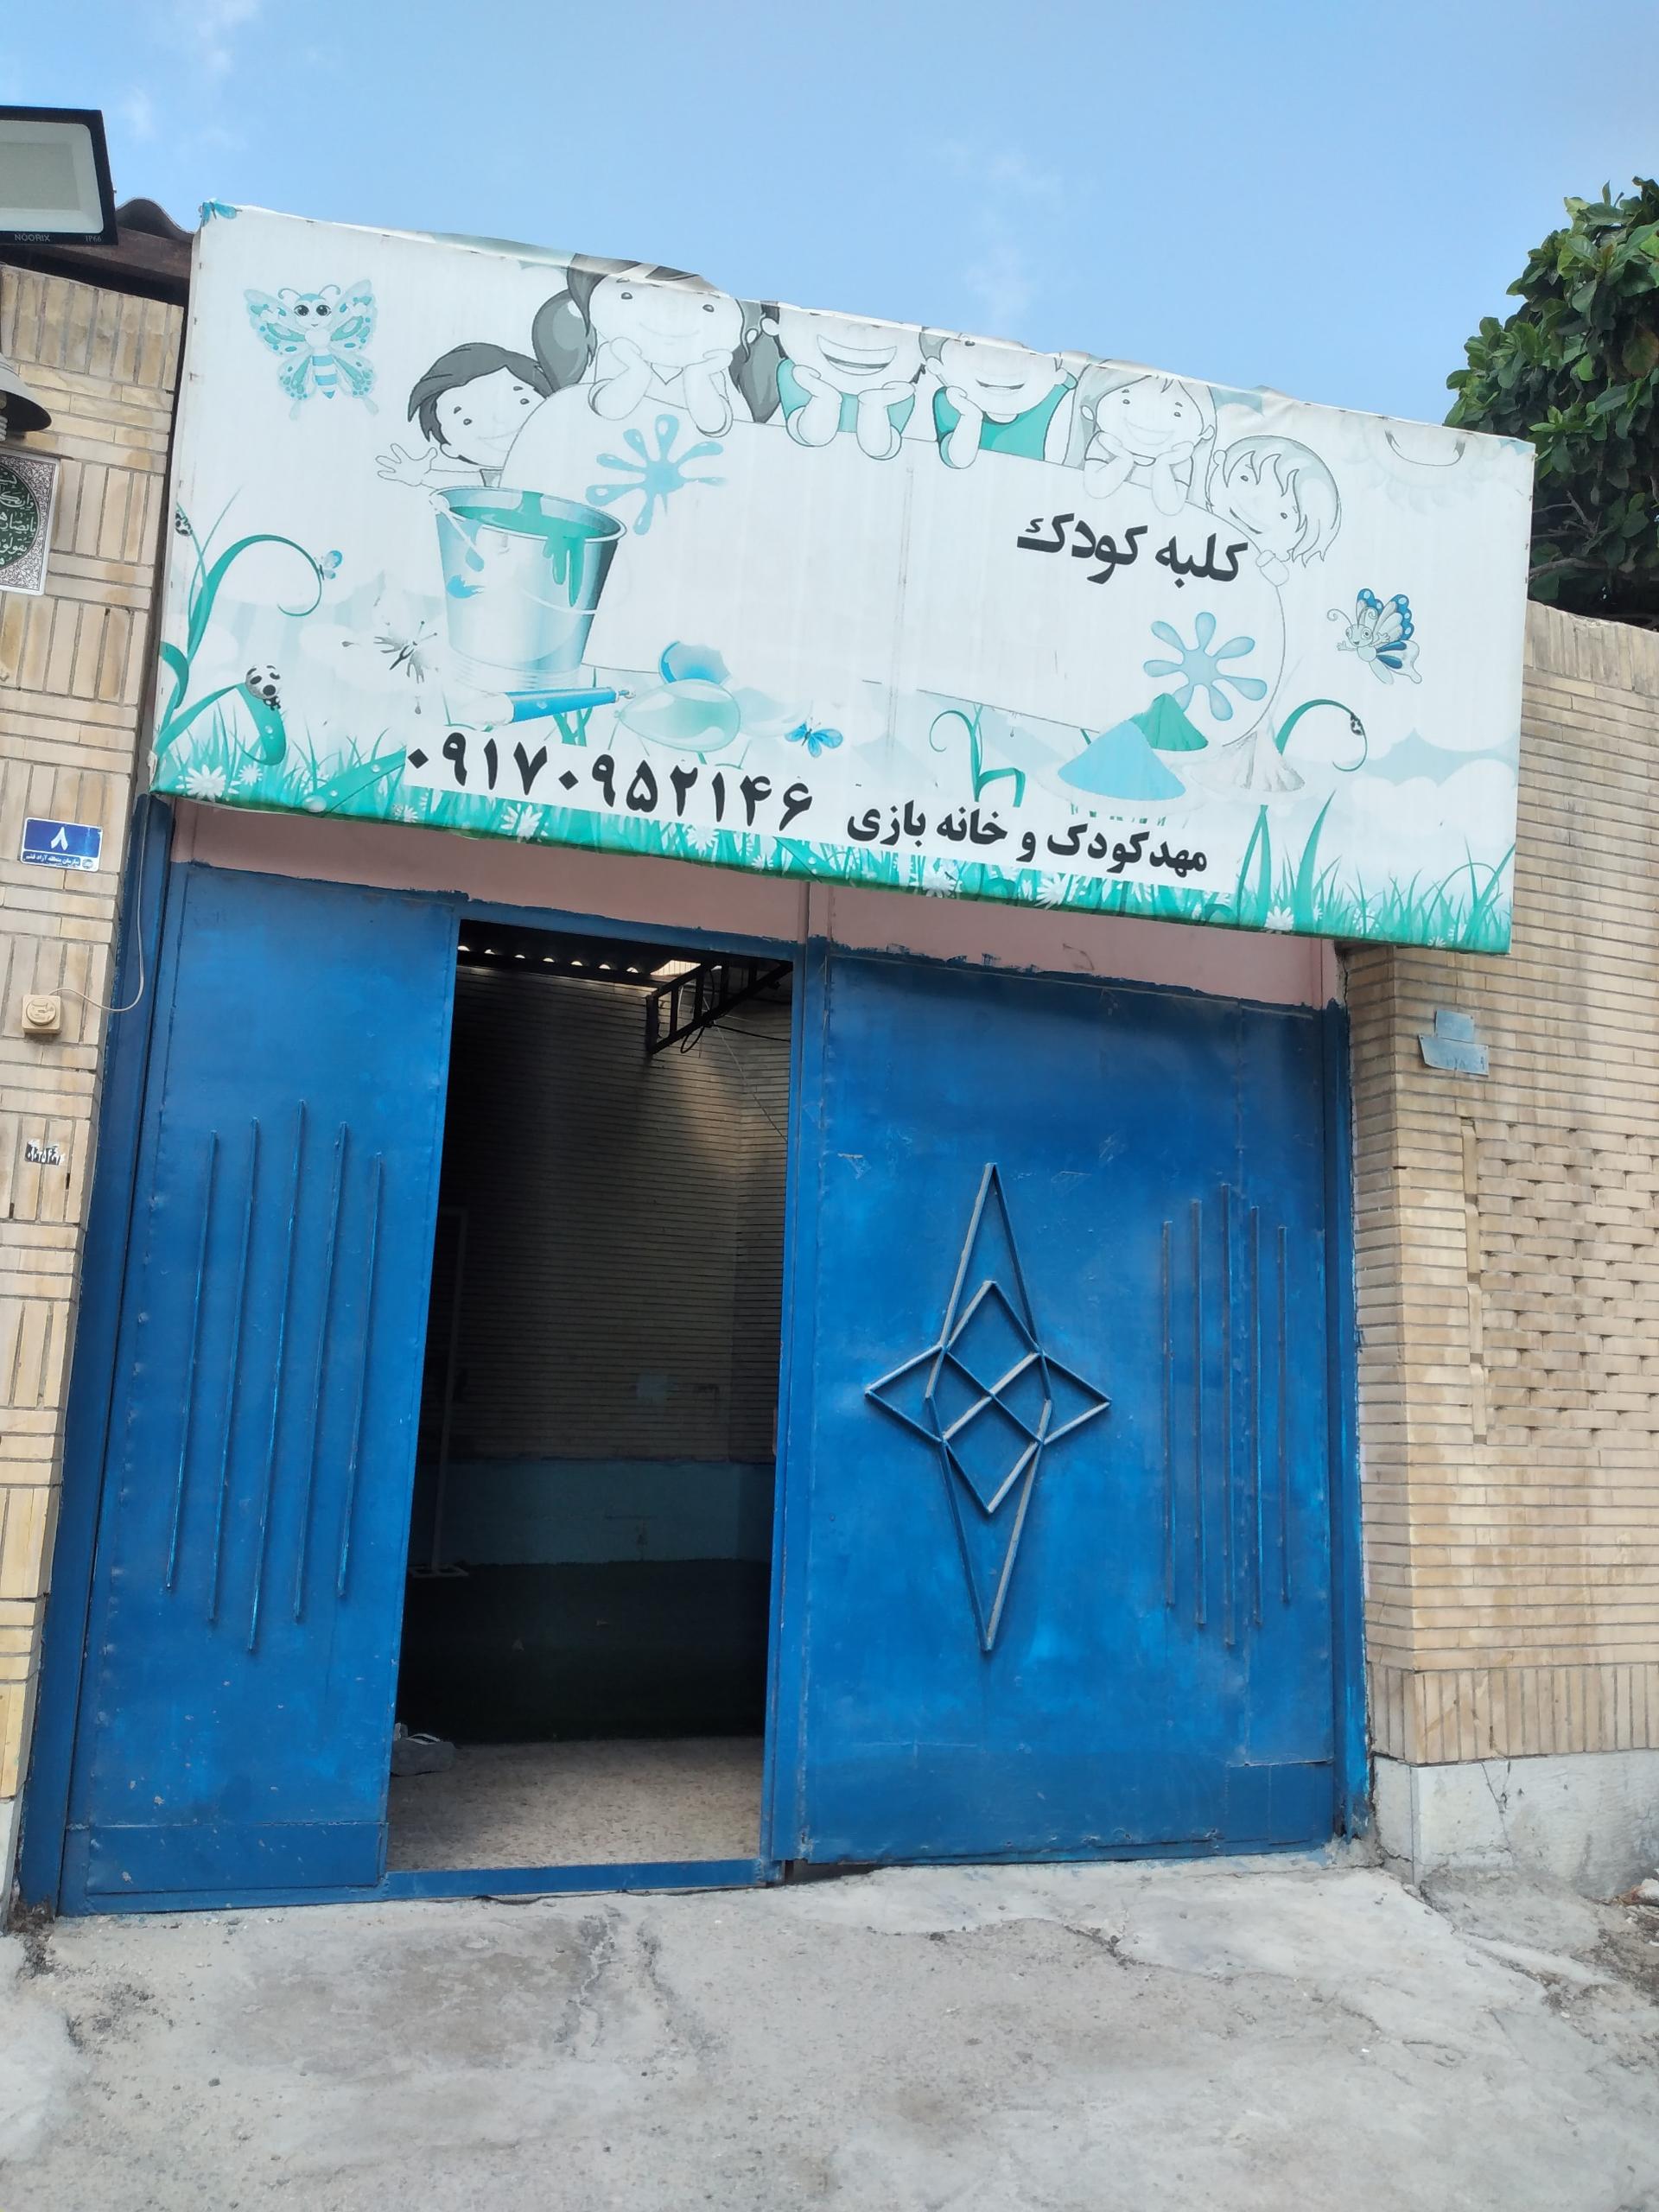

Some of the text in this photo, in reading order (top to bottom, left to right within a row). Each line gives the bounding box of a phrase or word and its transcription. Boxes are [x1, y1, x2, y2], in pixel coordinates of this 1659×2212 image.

[15, 233, 50, 242] NOORIX
[1155, 533, 1248, 588] کلبه
[408, 732, 813, 831] ۰۹۱۷۰۹۵۲۱۴۶
[51, 826, 68, 850] ۸
[847, 800, 927, 847] بازی
[936, 807, 1008, 846] خانه
[1016, 830, 1037, 862] و
